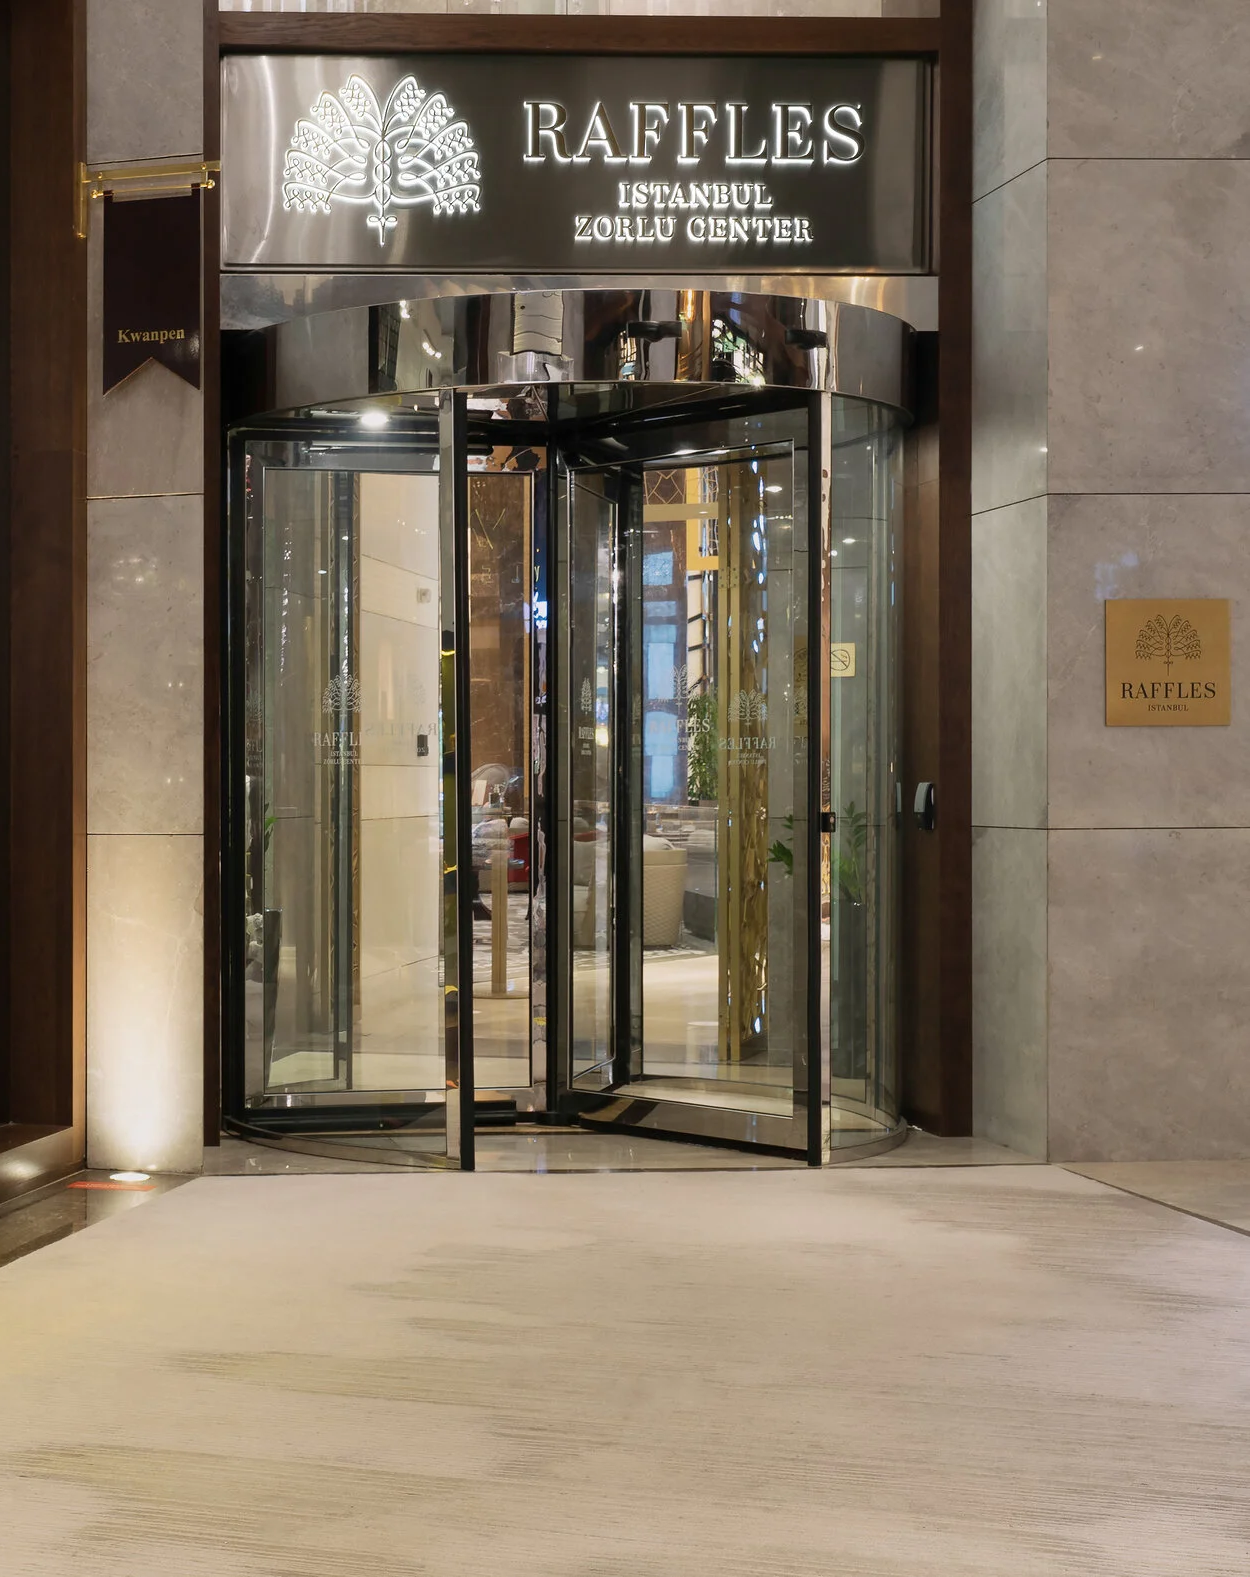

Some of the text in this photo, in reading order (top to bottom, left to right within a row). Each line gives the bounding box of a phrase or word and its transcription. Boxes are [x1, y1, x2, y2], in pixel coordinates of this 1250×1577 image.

[523, 100, 866, 163] RAFFLES
[618, 181, 773, 208] ISTANBUL
[574, 215, 814, 242] ZORLU CENTER
[117, 327, 185, 344] Kwanpen
[1121, 682, 1216, 699] RAFFLES
[1148, 704, 1189, 712] ISTANBUL
